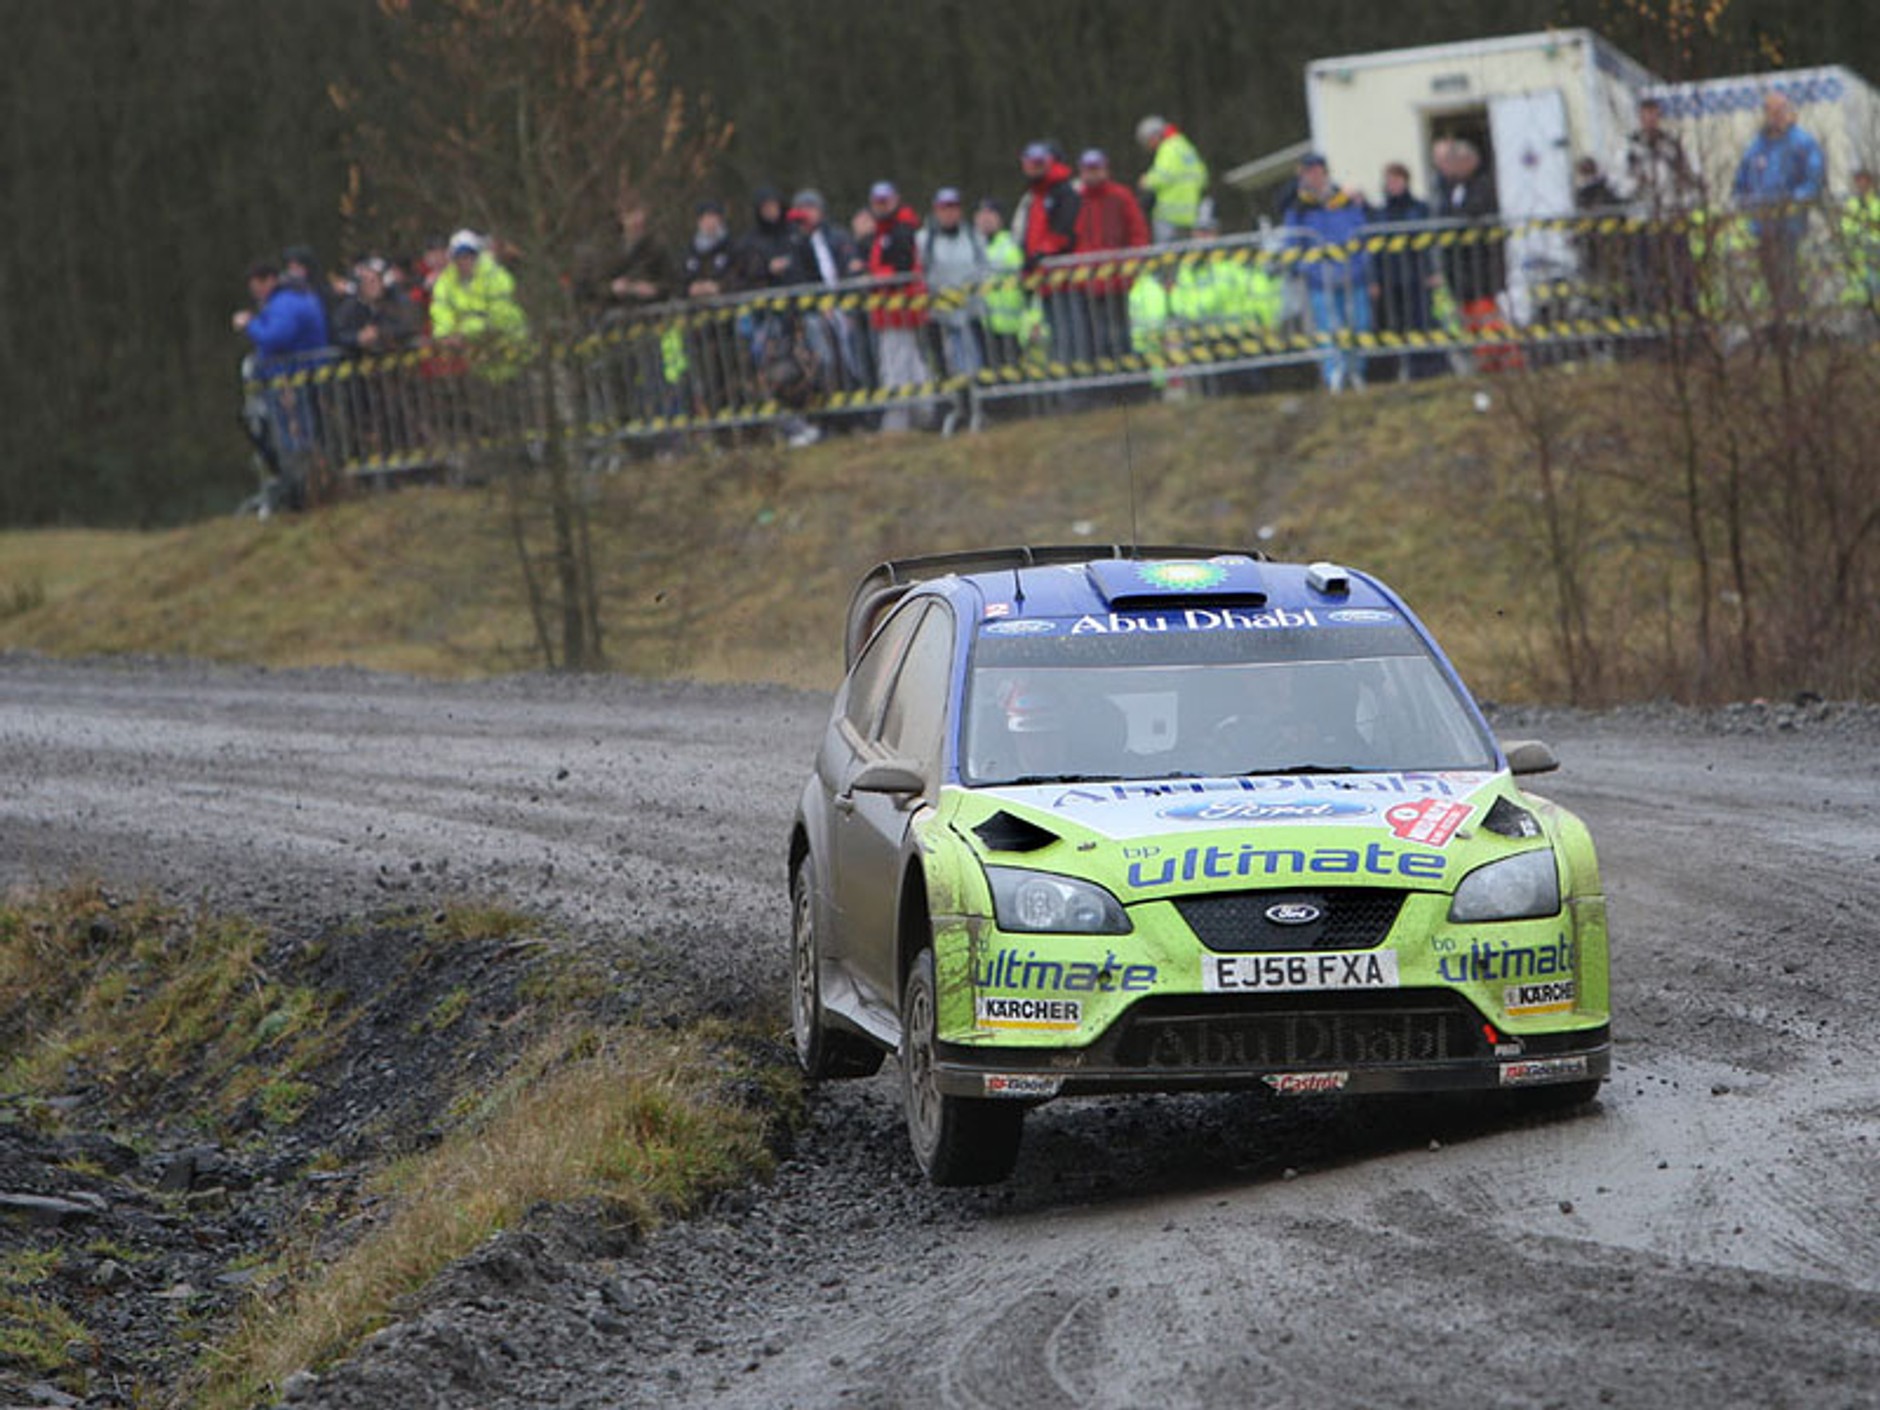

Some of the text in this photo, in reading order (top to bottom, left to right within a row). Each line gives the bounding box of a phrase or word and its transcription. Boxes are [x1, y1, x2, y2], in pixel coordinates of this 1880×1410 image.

[1071, 614, 1168, 635] Abu
[1184, 607, 1319, 633] Dhabi
[1199, 801, 1334, 819] Ford
[1123, 845, 1160, 860] bp
[1127, 844, 1447, 889] ultimate
[1278, 906, 1306, 919] Ford
[975, 949, 1158, 992] ultimate
[1217, 954, 1384, 988] EJ56 FXA
[1280, 1075, 1338, 1092] Castrol
